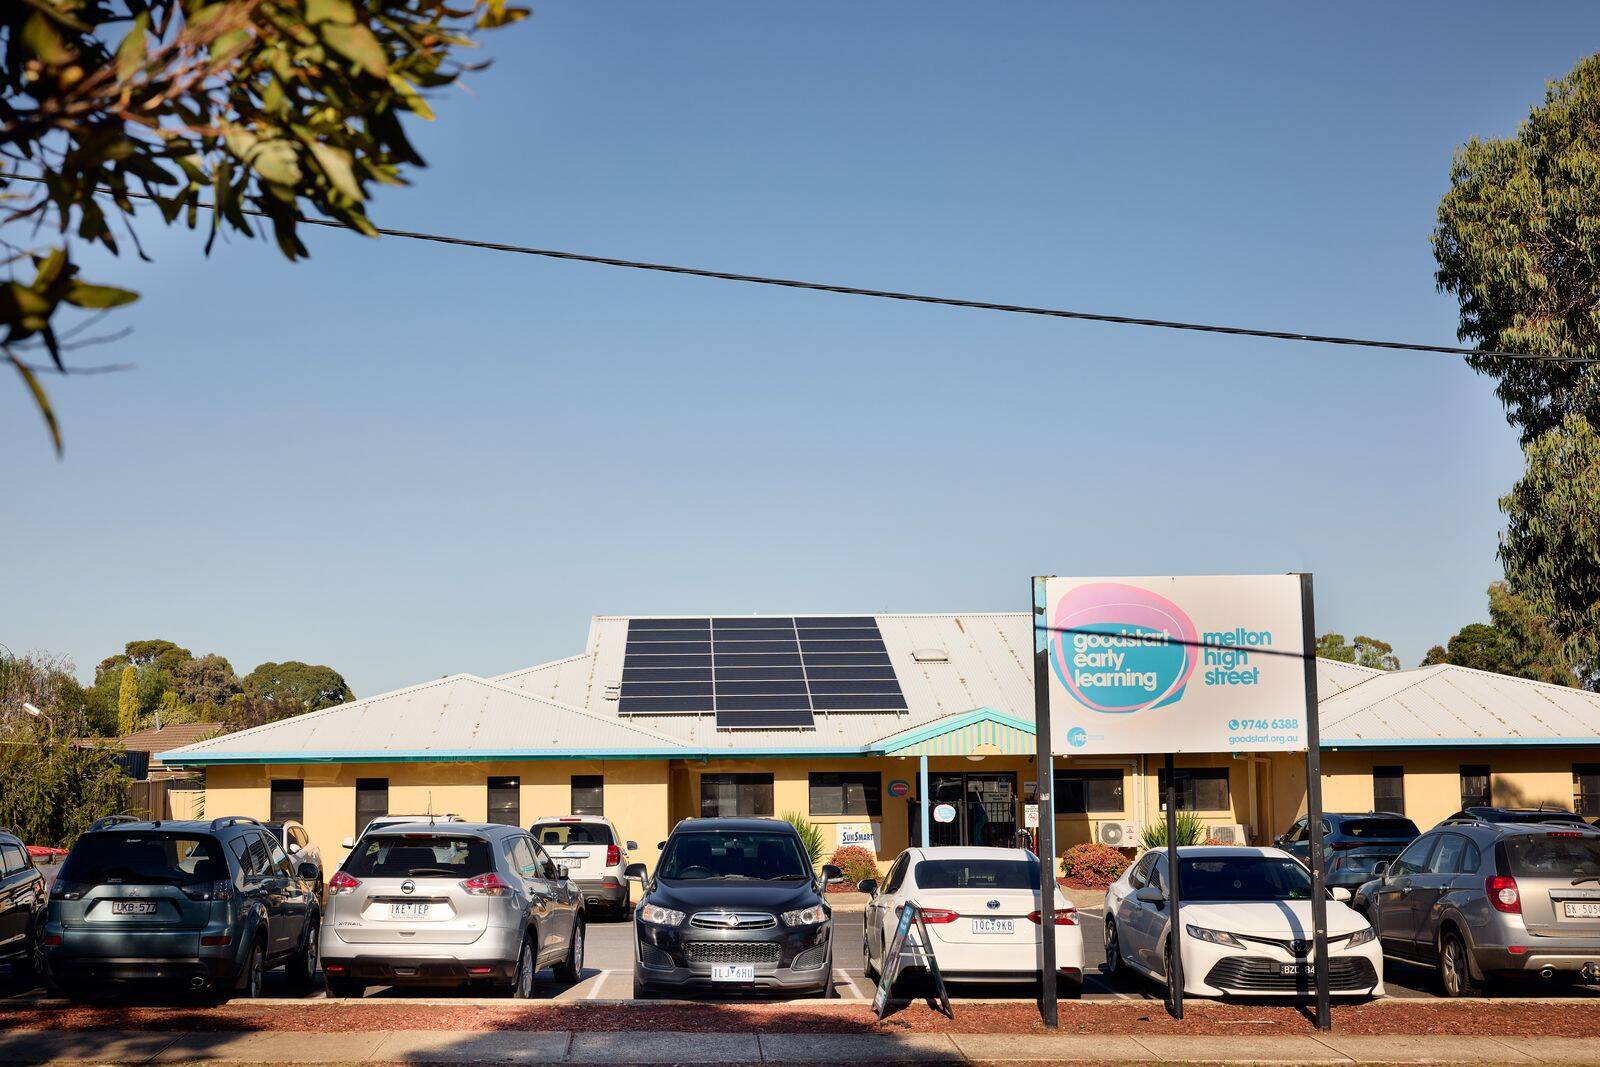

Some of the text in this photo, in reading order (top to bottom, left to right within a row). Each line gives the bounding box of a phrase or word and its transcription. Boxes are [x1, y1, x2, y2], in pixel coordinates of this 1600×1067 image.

[1073, 628, 1169, 653] goodstart
[1203, 627, 1272, 646] melton
[1073, 649, 1125, 671] early
[1204, 646, 1248, 671] high
[1075, 668, 1157, 691] learning
[1205, 667, 1260, 686] street
[1241, 719, 1298, 730] 9746 6388
[1229, 734, 1298, 745] goodstart.org.au
